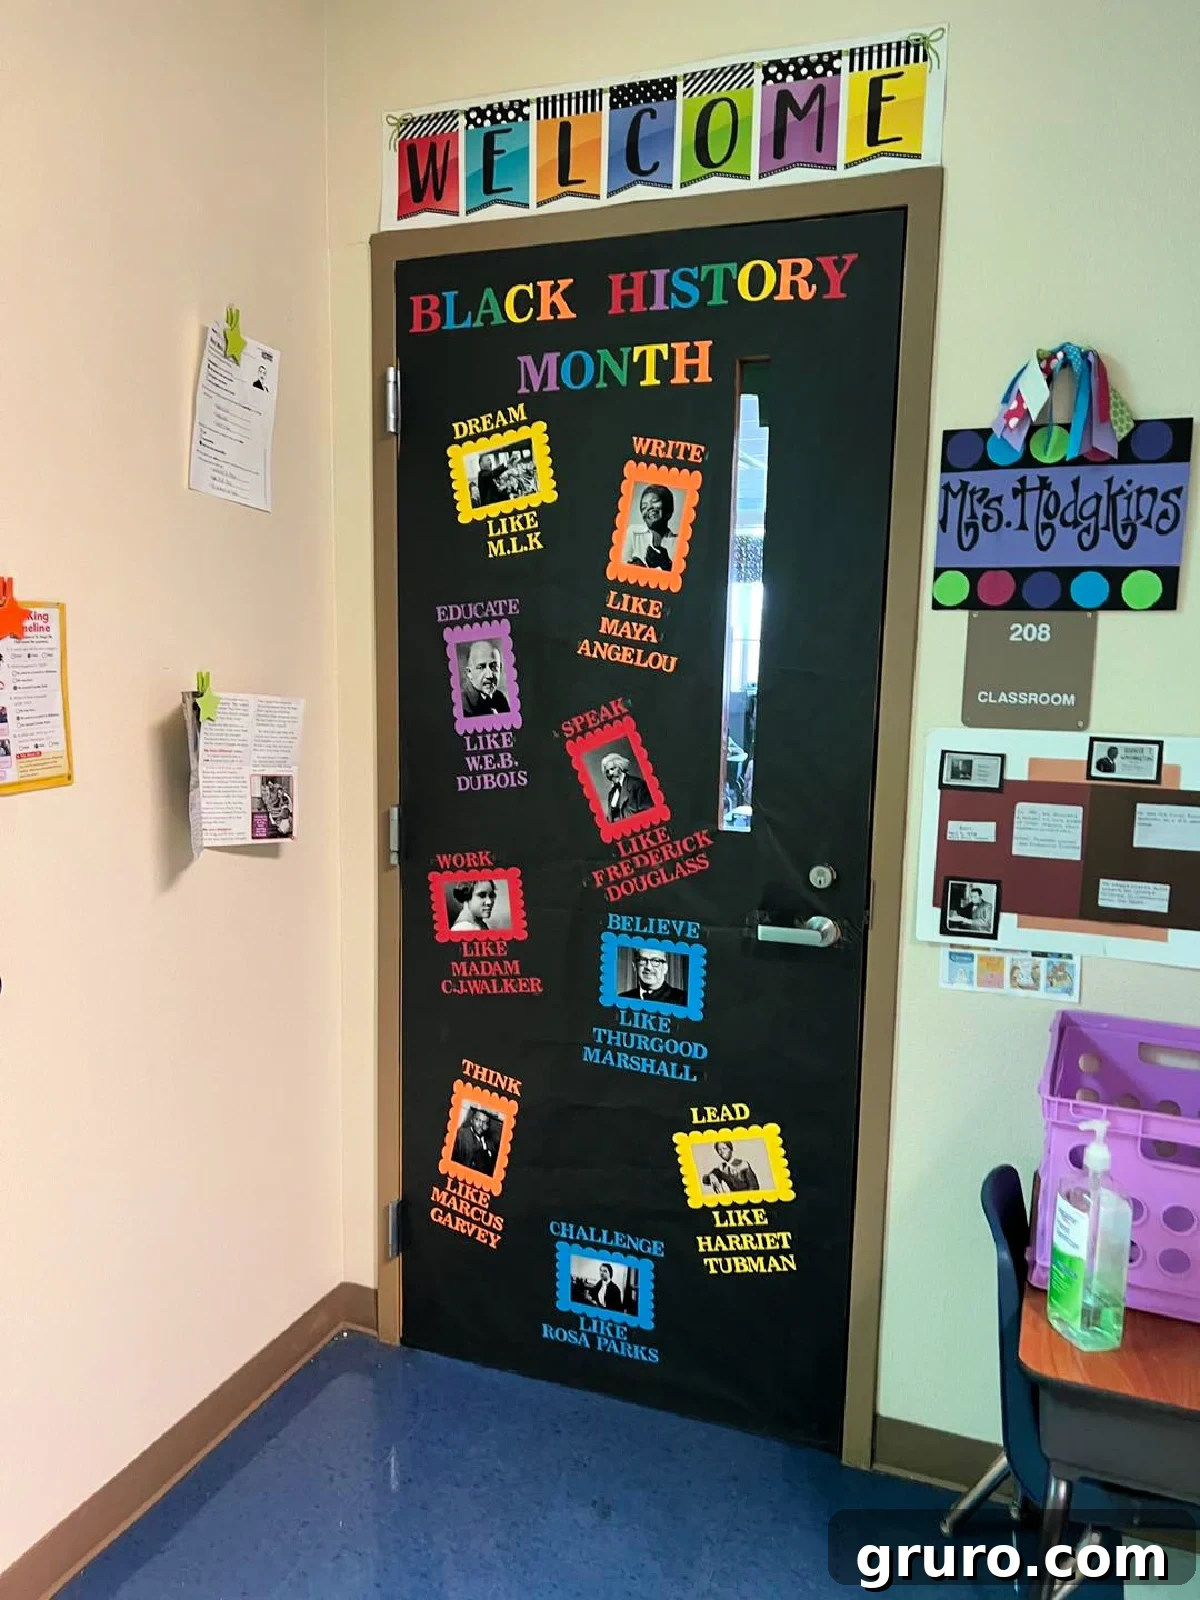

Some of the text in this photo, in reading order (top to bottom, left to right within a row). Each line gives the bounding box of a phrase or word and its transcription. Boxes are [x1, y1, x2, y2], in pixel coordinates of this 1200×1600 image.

[406, 71, 905, 203] WELCOME
[409, 253, 859, 333] BLACK HISTORY
[517, 341, 713, 394] MONTH
[452, 403, 528, 439] DREAM
[632, 436, 705, 463] WRITE
[487, 511, 539, 537] LIKE
[938, 474, 1184, 551] Mrs. Hodgkins
[487, 532, 543, 558] M.L.K
[436, 598, 520, 622] EDUCATE
[606, 591, 663, 619] LIKE
[599, 617, 658, 643] MAYA
[1009, 623, 1051, 642] 208
[577, 639, 678, 673] ANGELOU
[977, 691, 1076, 706] CLASSROOM
[561, 697, 630, 738] SPEAK
[464, 732, 514, 751] LIKE
[466, 752, 519, 772] W.E.B.
[457, 771, 528, 791] DUBOIS
[616, 826, 671, 858] LIKE
[436, 850, 494, 869] WORK
[592, 829, 714, 888] FREDERICK
[606, 853, 710, 902] DOUGLASS
[607, 913, 700, 939] BELIEVE
[462, 940, 508, 957] LIKE
[451, 960, 521, 977] MADAM
[619, 1009, 672, 1034] LIKE
[592, 1027, 709, 1060] THURGOOD
[462, 1058, 523, 1097] THINK
[582, 1046, 697, 1082] MARSHALL
[690, 1103, 750, 1124] LEAD
[446, 1177, 491, 1209] LIKE
[431, 1186, 504, 1231] MARCUS
[712, 1208, 768, 1228] LIKE
[430, 1207, 501, 1249] GARVEY
[549, 1220, 665, 1257] CHALLENGE
[696, 1231, 792, 1252] HARRIET
[703, 1254, 797, 1274] TUBMAN
[579, 1316, 628, 1340] LIKE
[541, 1323, 660, 1363] ROSA PARKS
